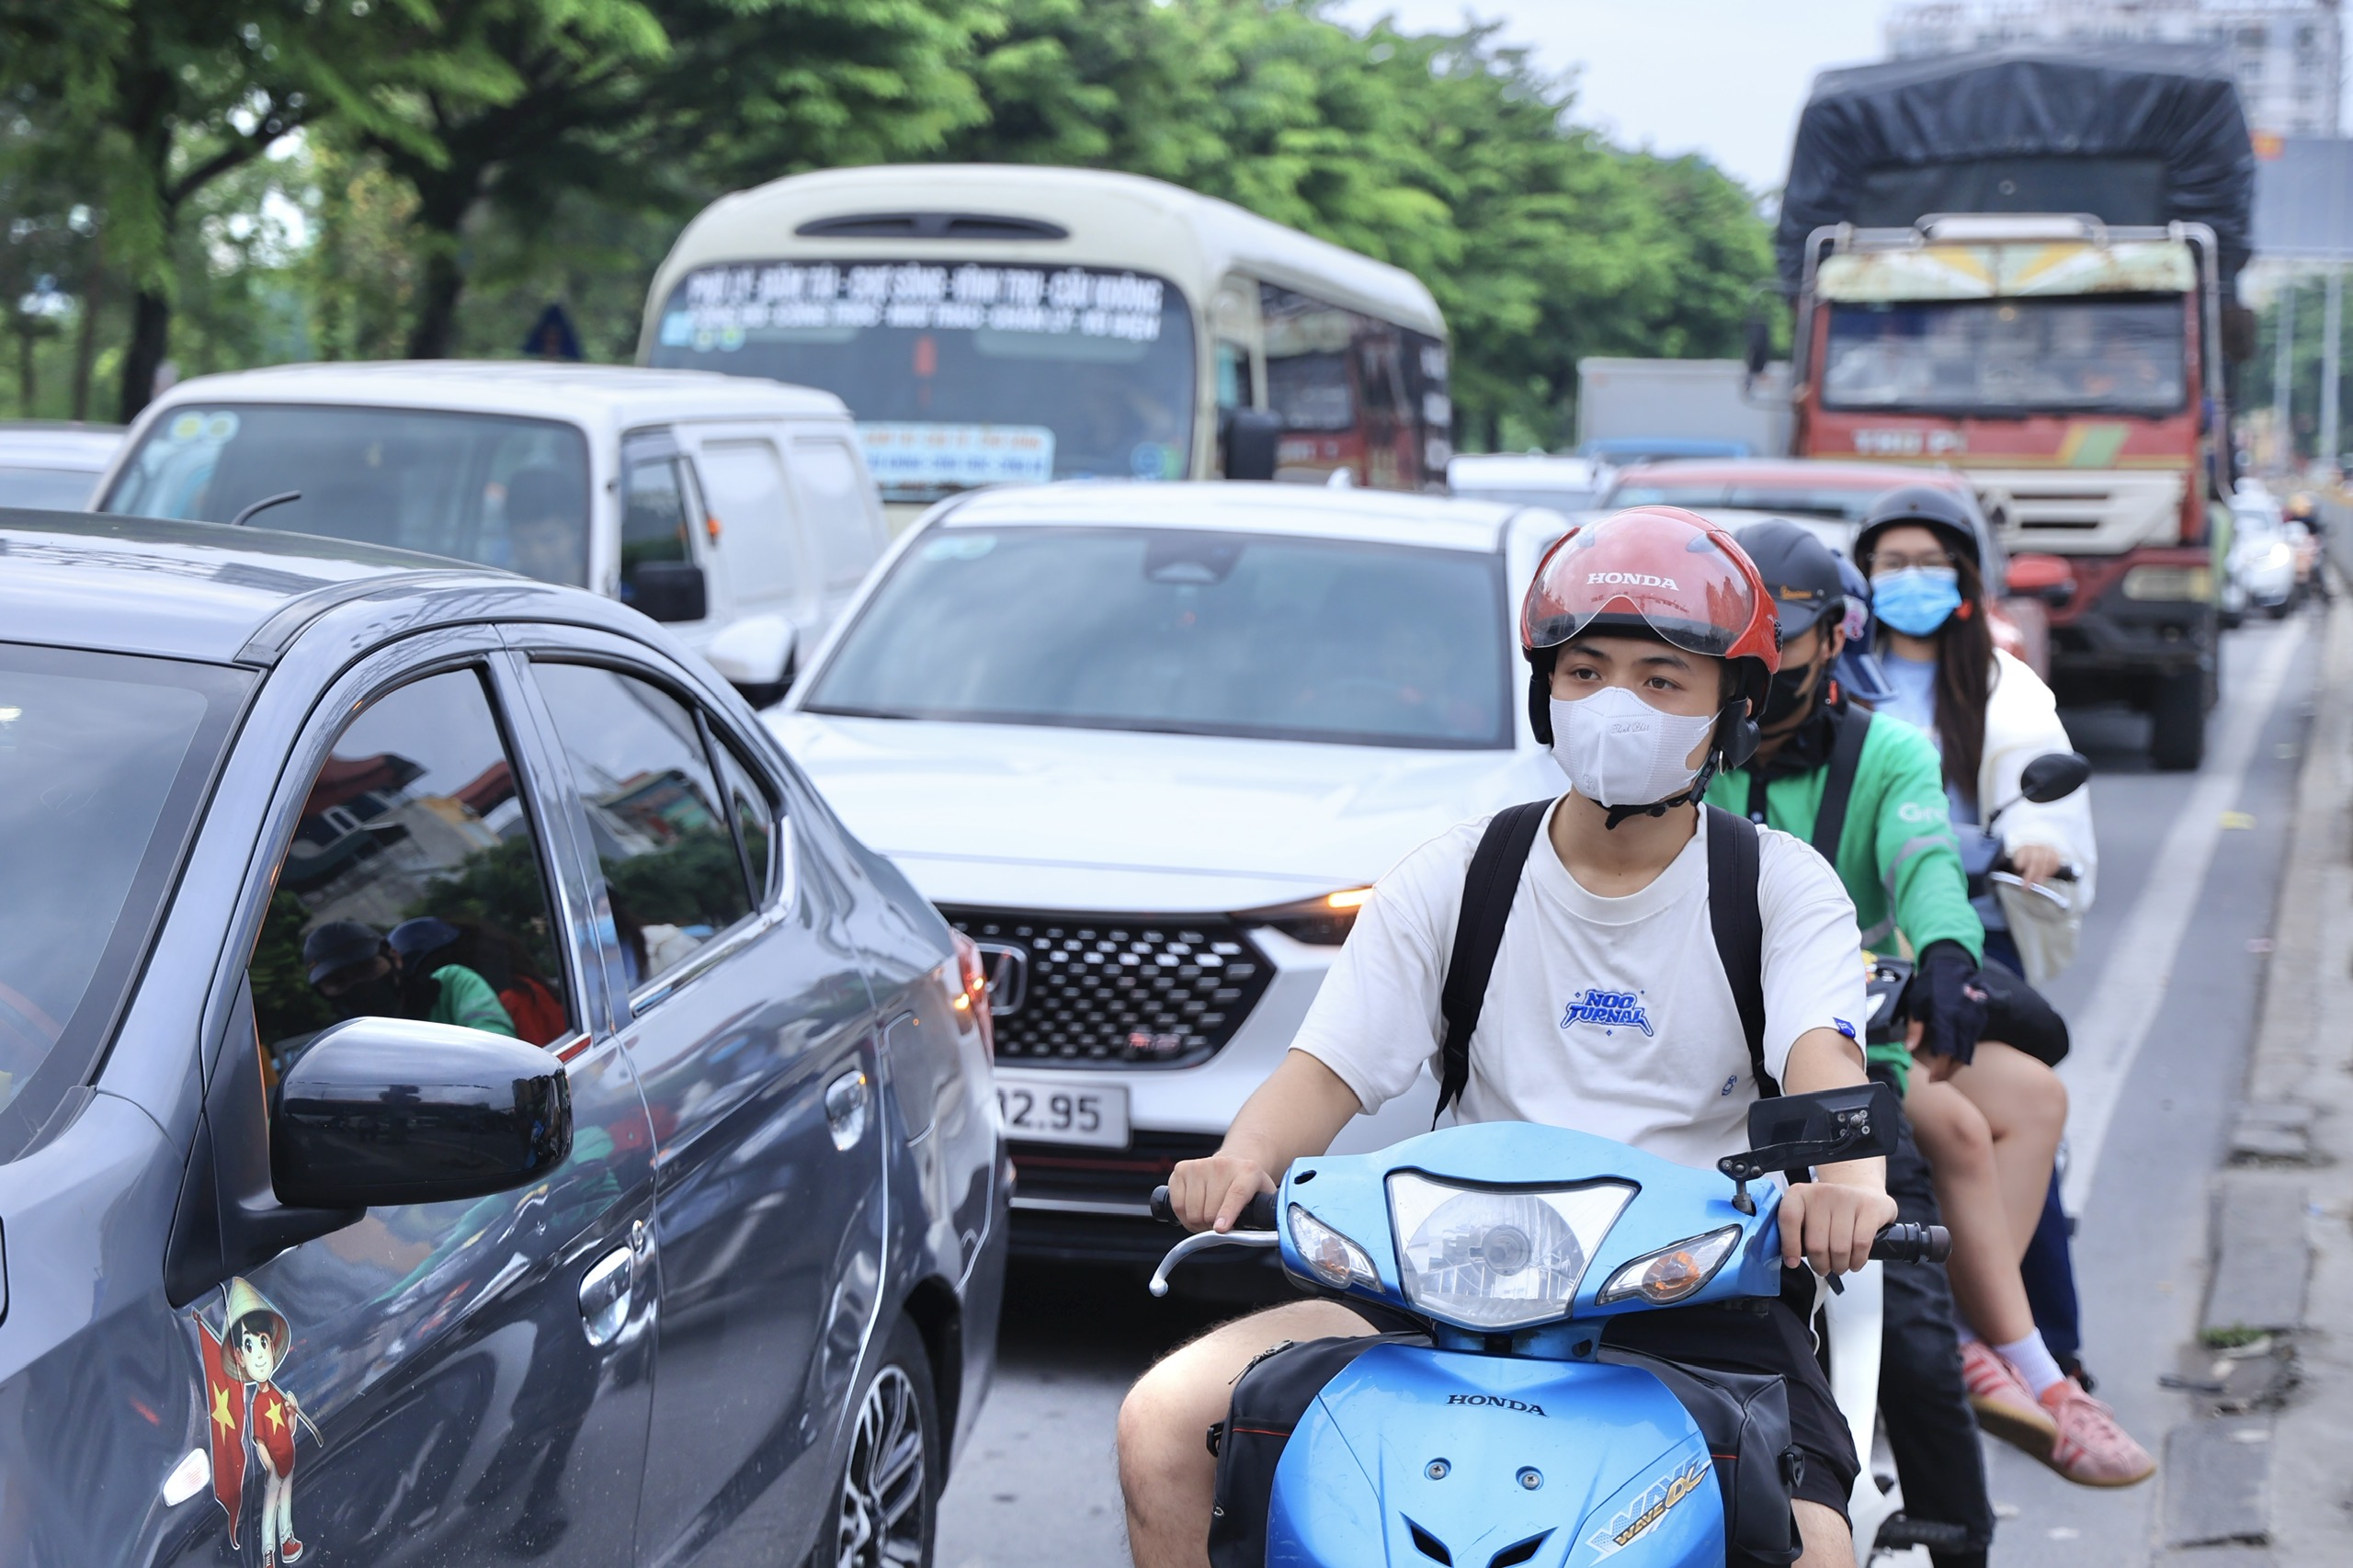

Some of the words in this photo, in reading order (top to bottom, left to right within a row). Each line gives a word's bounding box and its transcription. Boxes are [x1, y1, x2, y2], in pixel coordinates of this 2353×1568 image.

[1586, 572, 1679, 591] HONDA
[1584, 991, 1636, 1009] NOC
[1562, 1004, 1653, 1036] TURNAL
[1446, 1393, 1549, 1417] HONDA
[1614, 1500, 1665, 1546] WAVE
